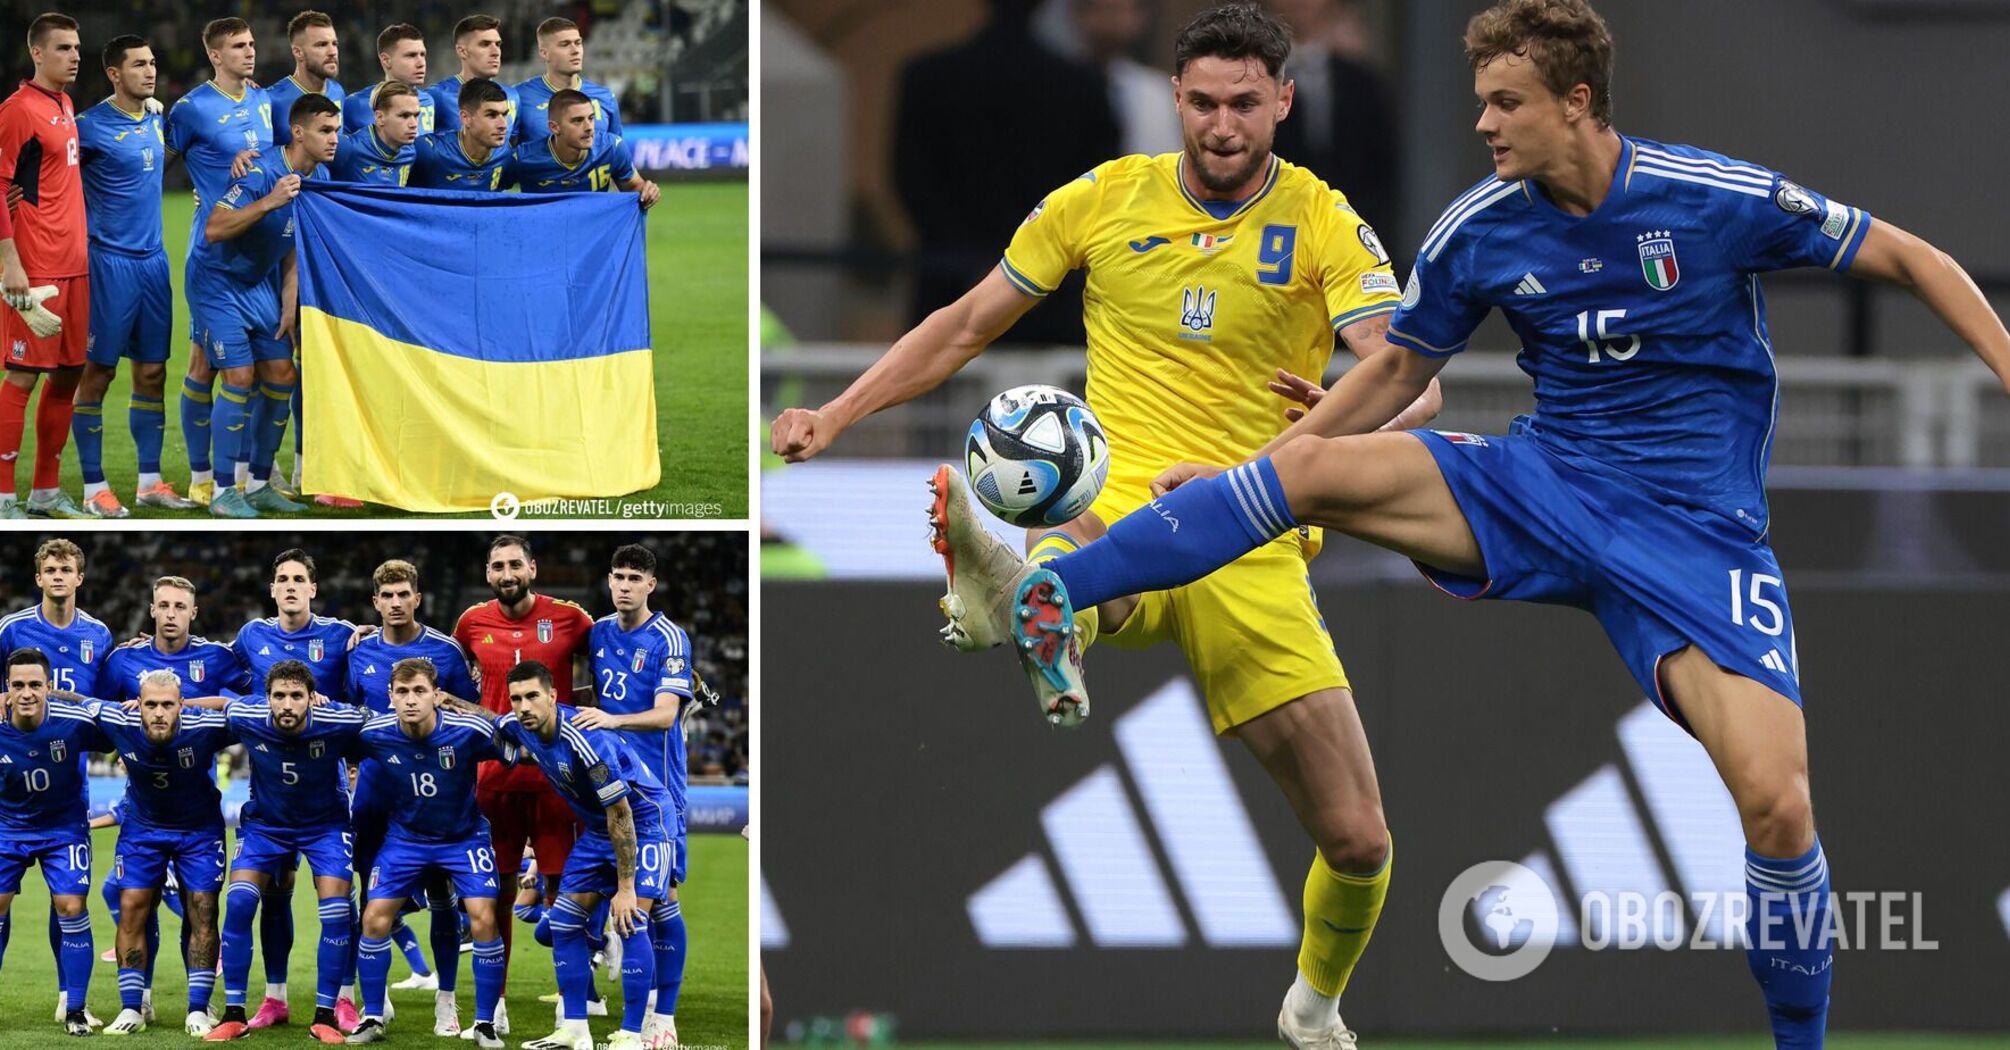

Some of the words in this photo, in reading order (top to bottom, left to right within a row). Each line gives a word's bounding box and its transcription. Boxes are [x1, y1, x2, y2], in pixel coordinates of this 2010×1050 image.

[66, 137, 78, 167] 12
[1257, 223, 1298, 286] 9
[1641, 242, 1671, 257] ITALIA
[1576, 308, 1641, 364] 15
[1728, 568, 1784, 636] 15
[53, 667, 76, 692] 15
[602, 668, 628, 701] 23
[22, 767, 50, 793] 10
[152, 771, 169, 789] 3
[281, 762, 299, 786] 5
[410, 772, 438, 797] 18
[68, 844, 90, 871] 10
[214, 840, 225, 868] 3
[466, 847, 494, 874] 18
[1770, 954, 1834, 976] ITALIA
